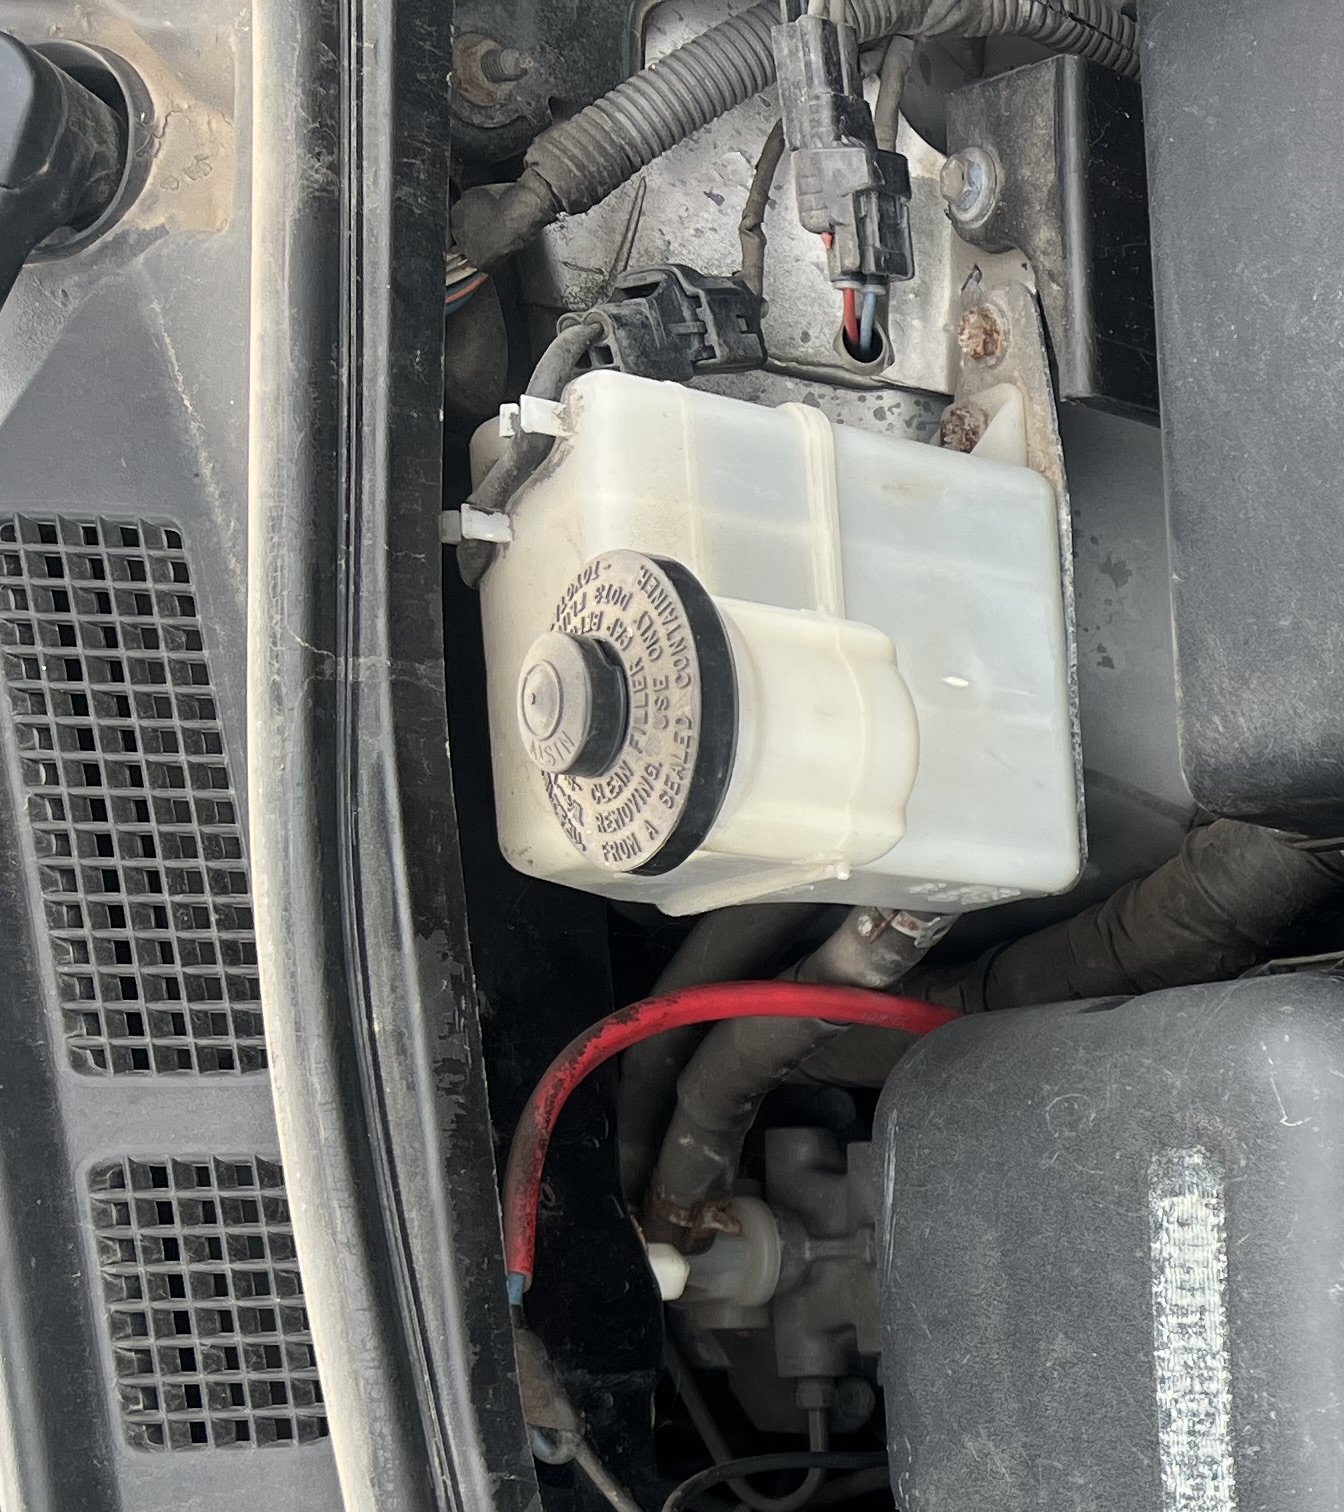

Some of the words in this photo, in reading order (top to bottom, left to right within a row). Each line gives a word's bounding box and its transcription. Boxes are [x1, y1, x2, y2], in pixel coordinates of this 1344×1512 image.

[606, 617, 633, 651] CAP
[629, 657, 648, 754] FILLER
[530, 730, 575, 766] AISIN
[591, 760, 634, 804] CLEAN
[595, 762, 663, 833] REMOVING.
[653, 675, 669, 729] USE
[602, 833, 642, 862] FROM
[644, 819, 659, 840] A
[659, 716, 692, 809] SEALED
